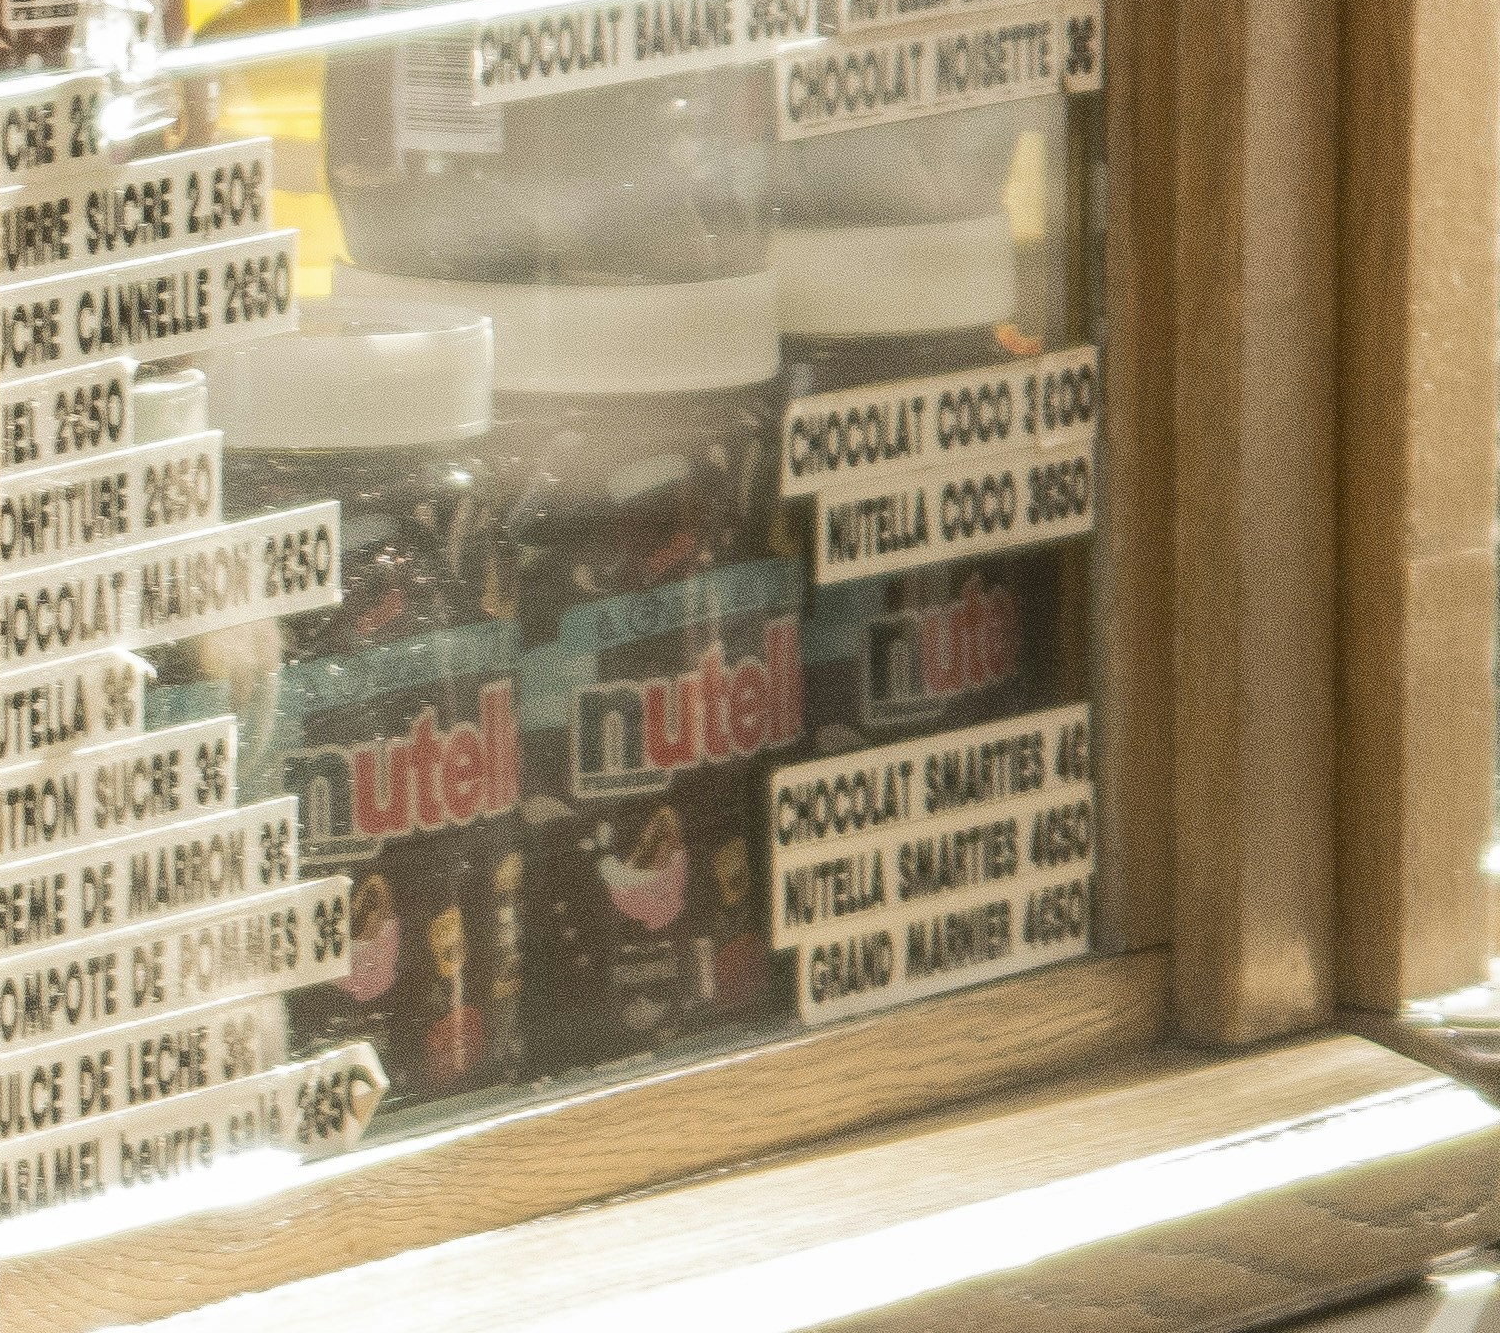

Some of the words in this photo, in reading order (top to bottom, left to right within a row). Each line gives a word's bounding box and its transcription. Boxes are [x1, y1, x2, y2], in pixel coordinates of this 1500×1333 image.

[481, 5, 622, 88] CHOCOLAT
[788, 40, 924, 123] CHOCOLAT
[937, 19, 1052, 94] NOISETTE
[86, 178, 172, 256] SUCRE
[76, 268, 209, 355] CANNELLE
[223, 250, 291, 325] 2€50
[53, 377, 125, 455] 2€50
[790, 396, 924, 478] CHOCOLAT
[938, 379, 1013, 450] COCO
[143, 452, 213, 529] 2€50
[828, 487, 930, 564] NUTELLA
[941, 470, 1016, 543] COCO
[140, 541, 252, 630] MAISON
[261, 523, 331, 599] 2€50
[95, 748, 182, 830] SUCRE
[777, 759, 914, 847] CHOCOLAT
[923, 729, 1045, 815] SMARTIES
[81, 861, 114, 930] DE
[130, 826, 247, 919] MARRON
[784, 847, 888, 929] NUTELLA
[896, 814, 1019, 902] SMARTIES
[132, 939, 164, 1008] DE
[179, 906, 299, 997] POMMES
[810, 928, 895, 1003] GRAND
[78, 1050, 113, 1117] DE
[125, 1024, 208, 1106] LECHE
